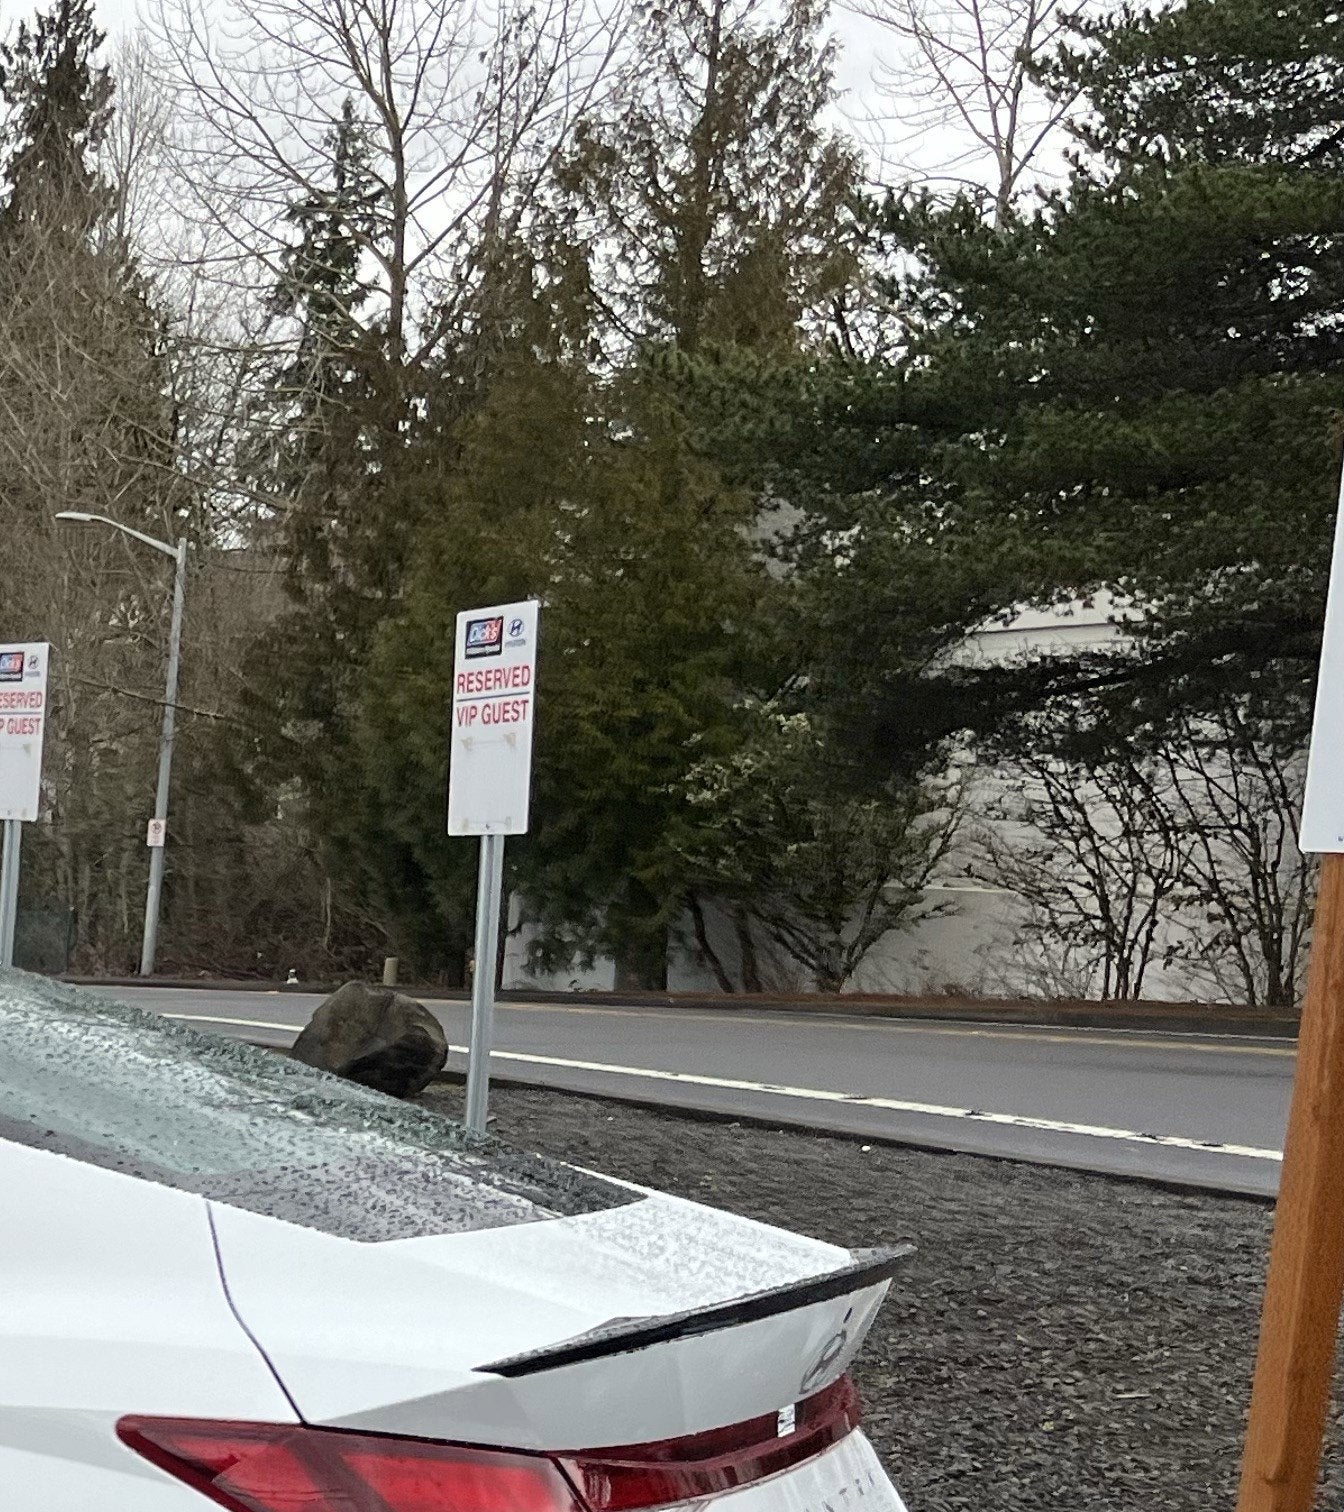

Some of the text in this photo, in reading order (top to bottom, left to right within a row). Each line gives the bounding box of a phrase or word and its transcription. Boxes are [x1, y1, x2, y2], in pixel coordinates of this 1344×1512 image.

[457, 665, 531, 694] RESERVED
[7, 718, 41, 735] GUEST
[457, 701, 529, 727] VIP GUEST
